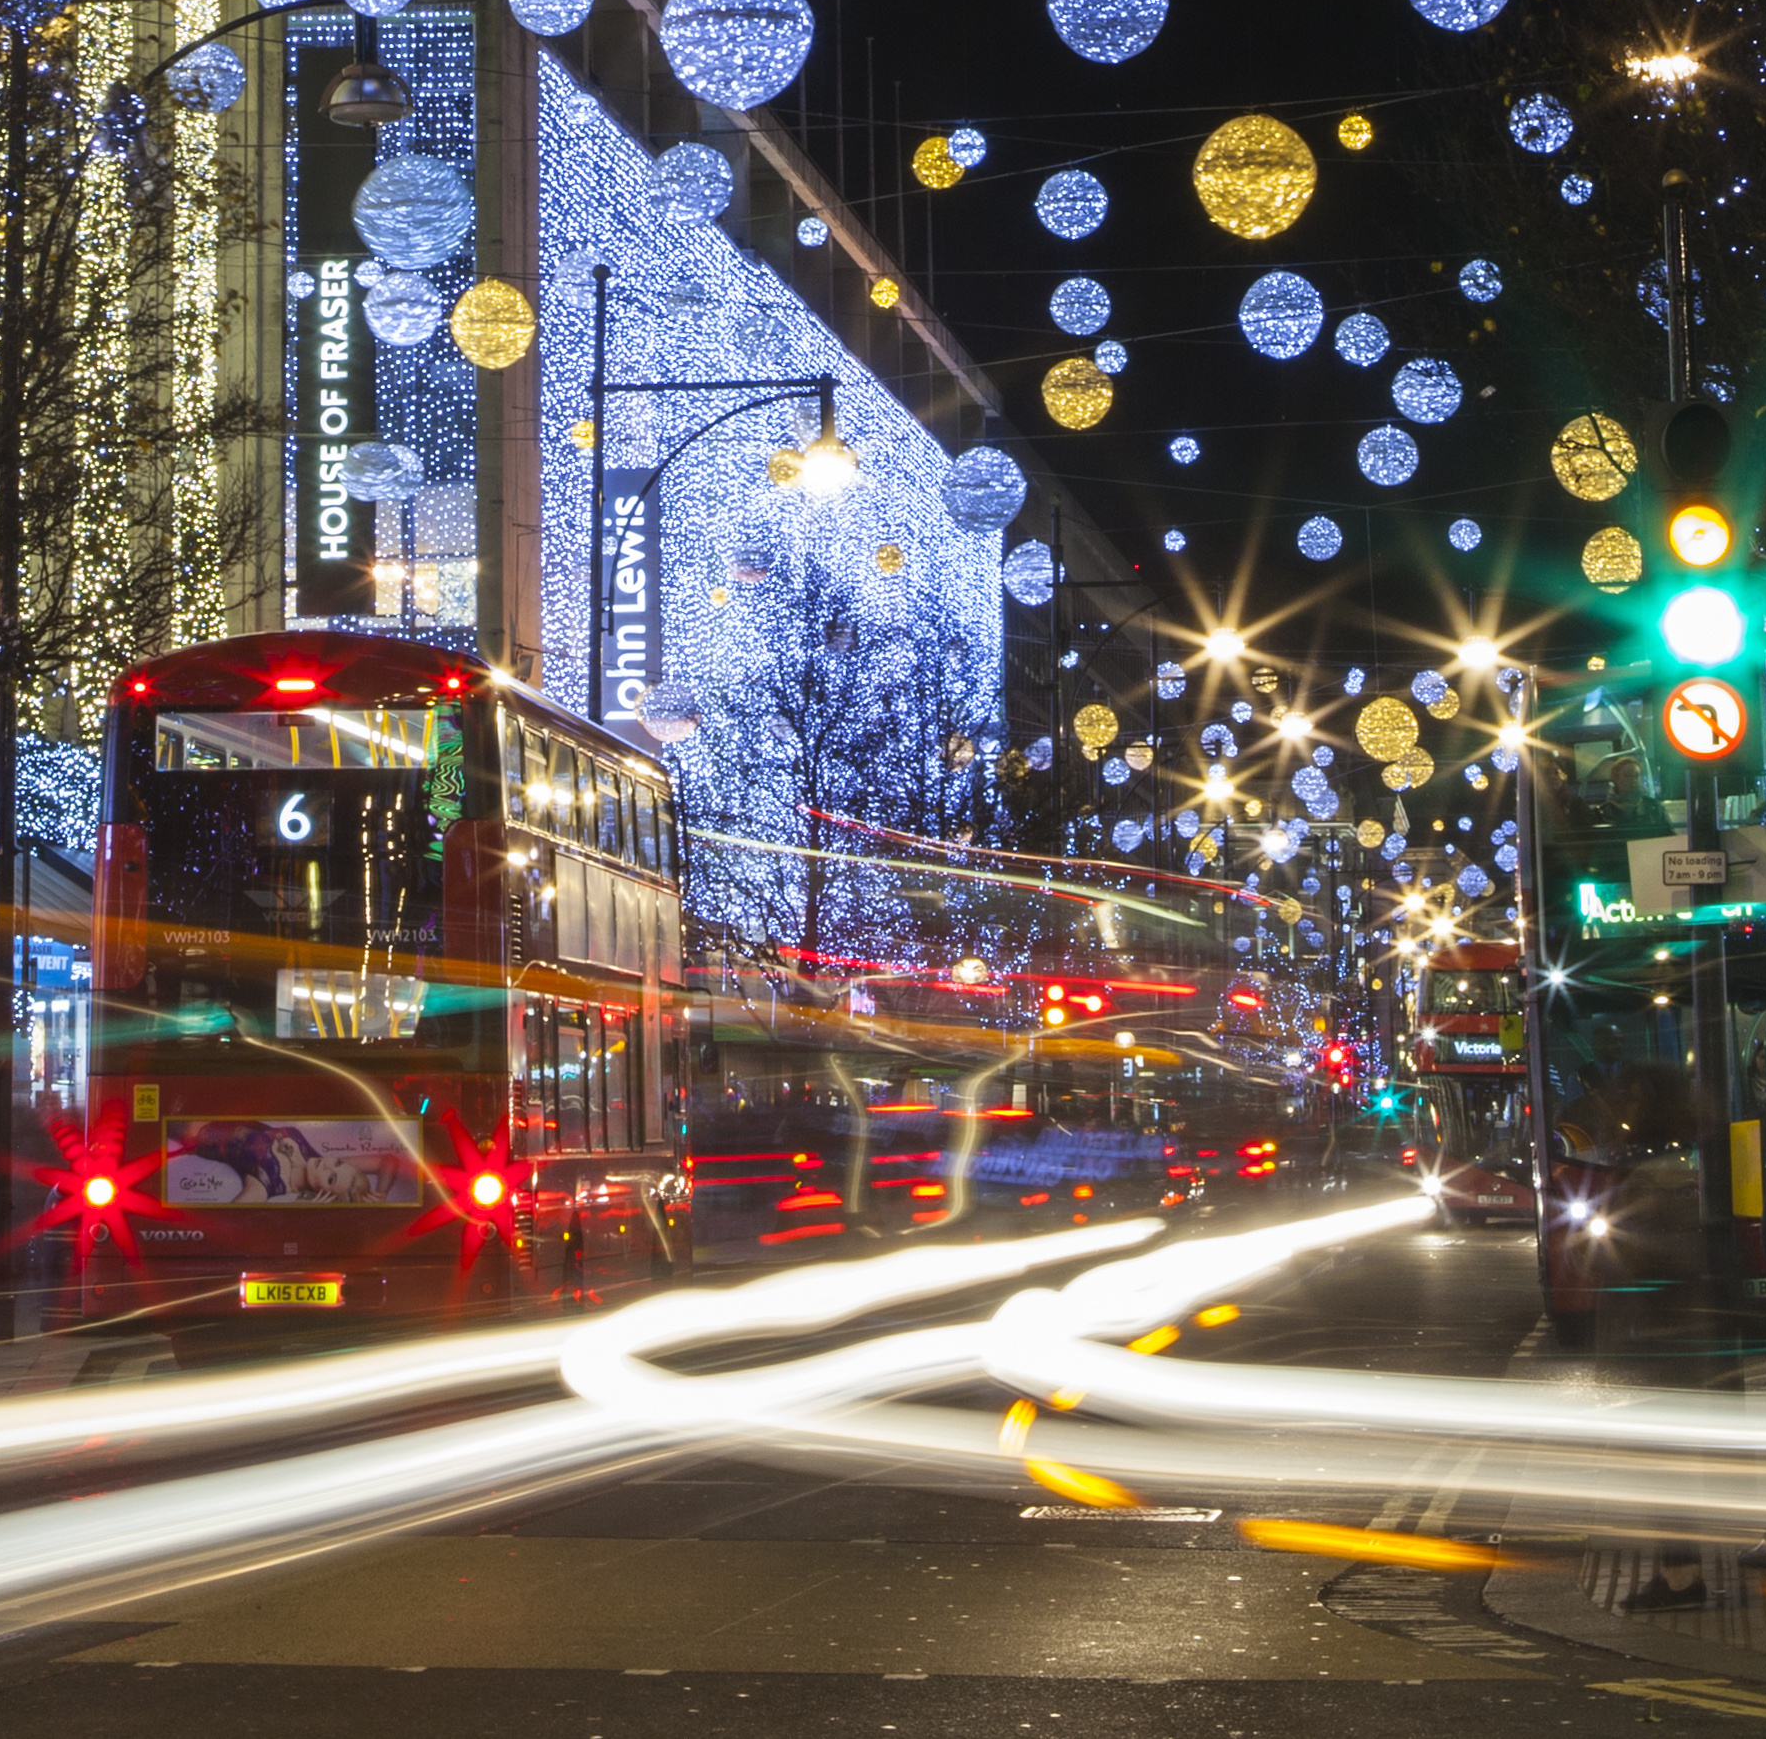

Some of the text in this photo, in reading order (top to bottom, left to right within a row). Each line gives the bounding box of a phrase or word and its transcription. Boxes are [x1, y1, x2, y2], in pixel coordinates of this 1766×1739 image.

[319, 259, 350, 561] HOUSE OF FRASER
[604, 495, 647, 721] John Lewis
[278, 792, 312, 842] 6
[1668, 855, 1723, 868] No loading
[163, 930, 230, 944] VWH2103
[368, 928, 436, 943] VWH2103
[32, 955, 70, 971] VENT
[1453, 1040, 1503, 1055] Victoria
[139, 1230, 204, 1242] VOLVO
[256, 1284, 327, 1302] LK15 CXB
